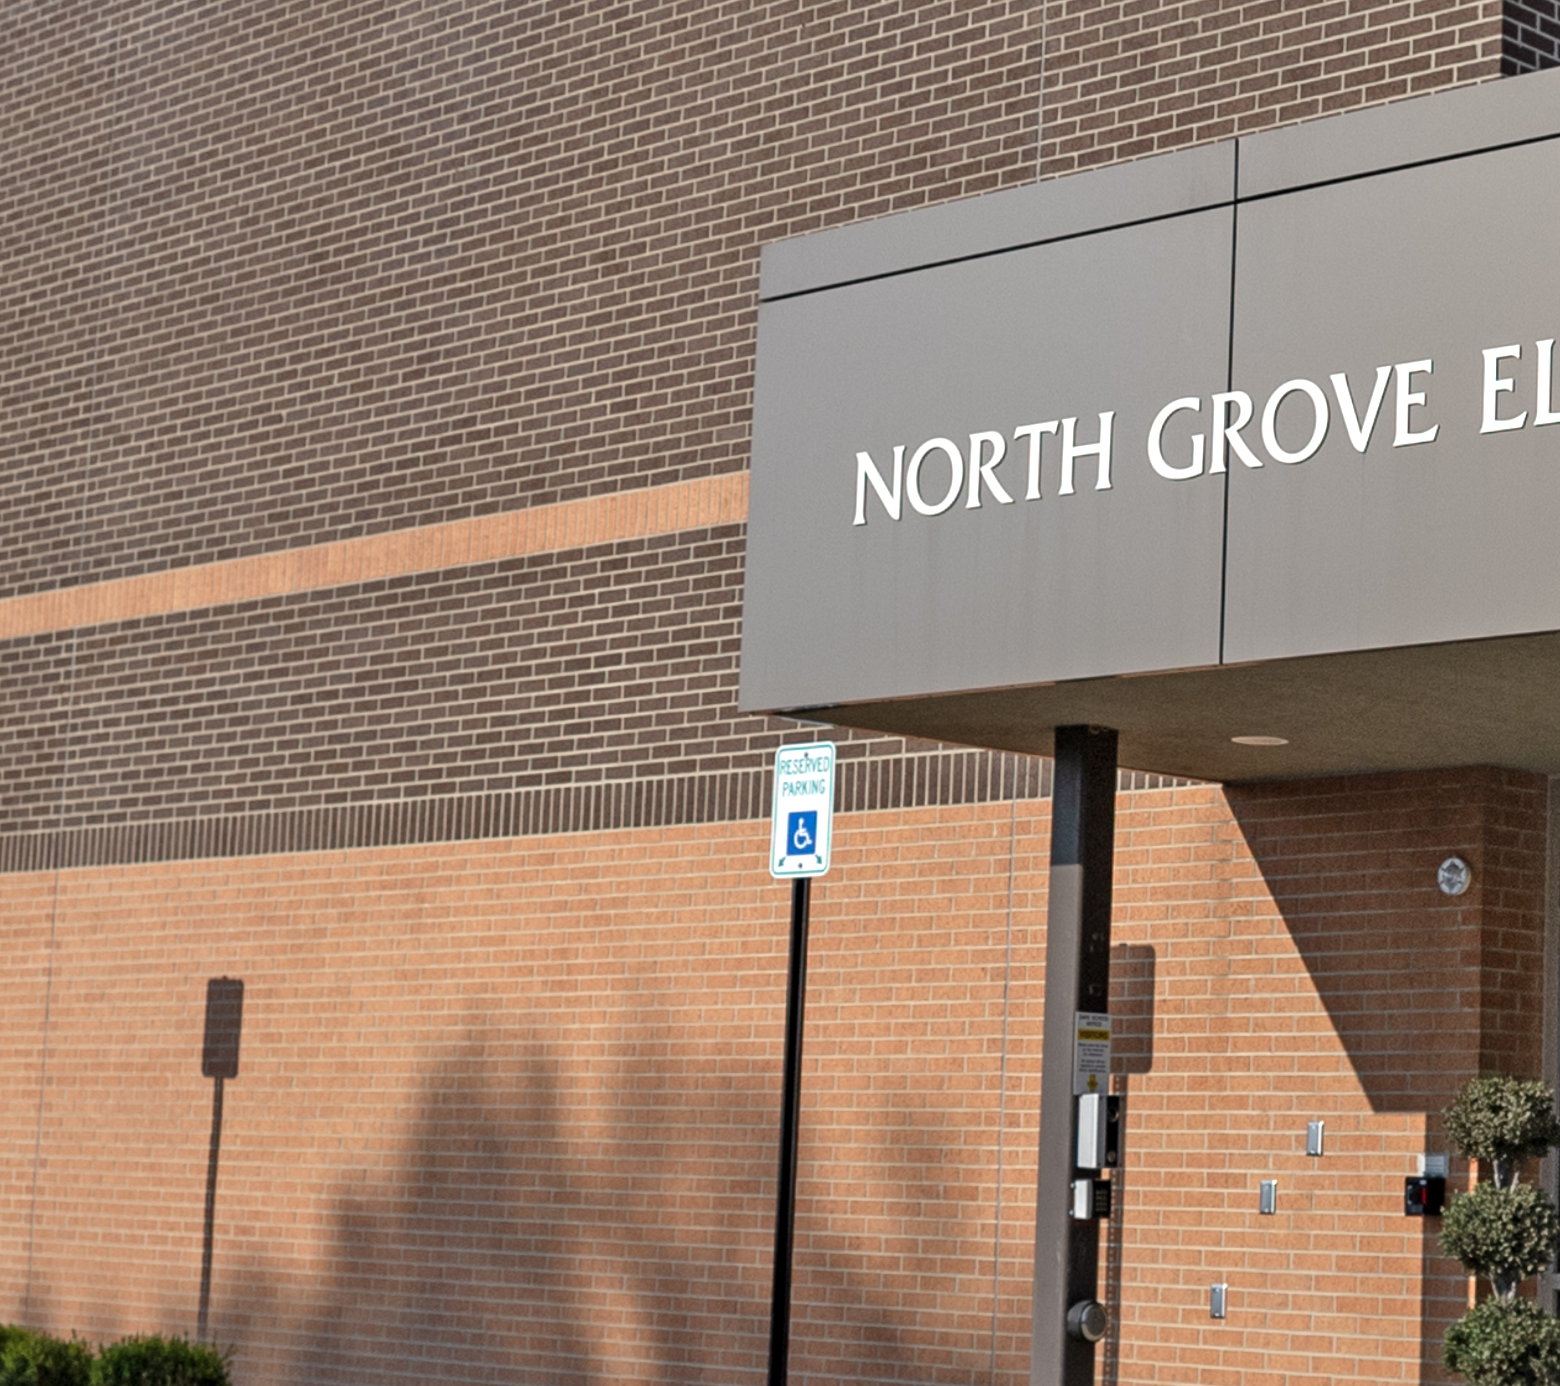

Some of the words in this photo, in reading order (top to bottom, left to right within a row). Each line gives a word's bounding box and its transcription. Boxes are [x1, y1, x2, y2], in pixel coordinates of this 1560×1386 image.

[851, 410, 1115, 526] NORTH
[1145, 358, 1440, 481] GROVE
[780, 756, 830, 776] RESERVED
[782, 779, 826, 797] PARKING
